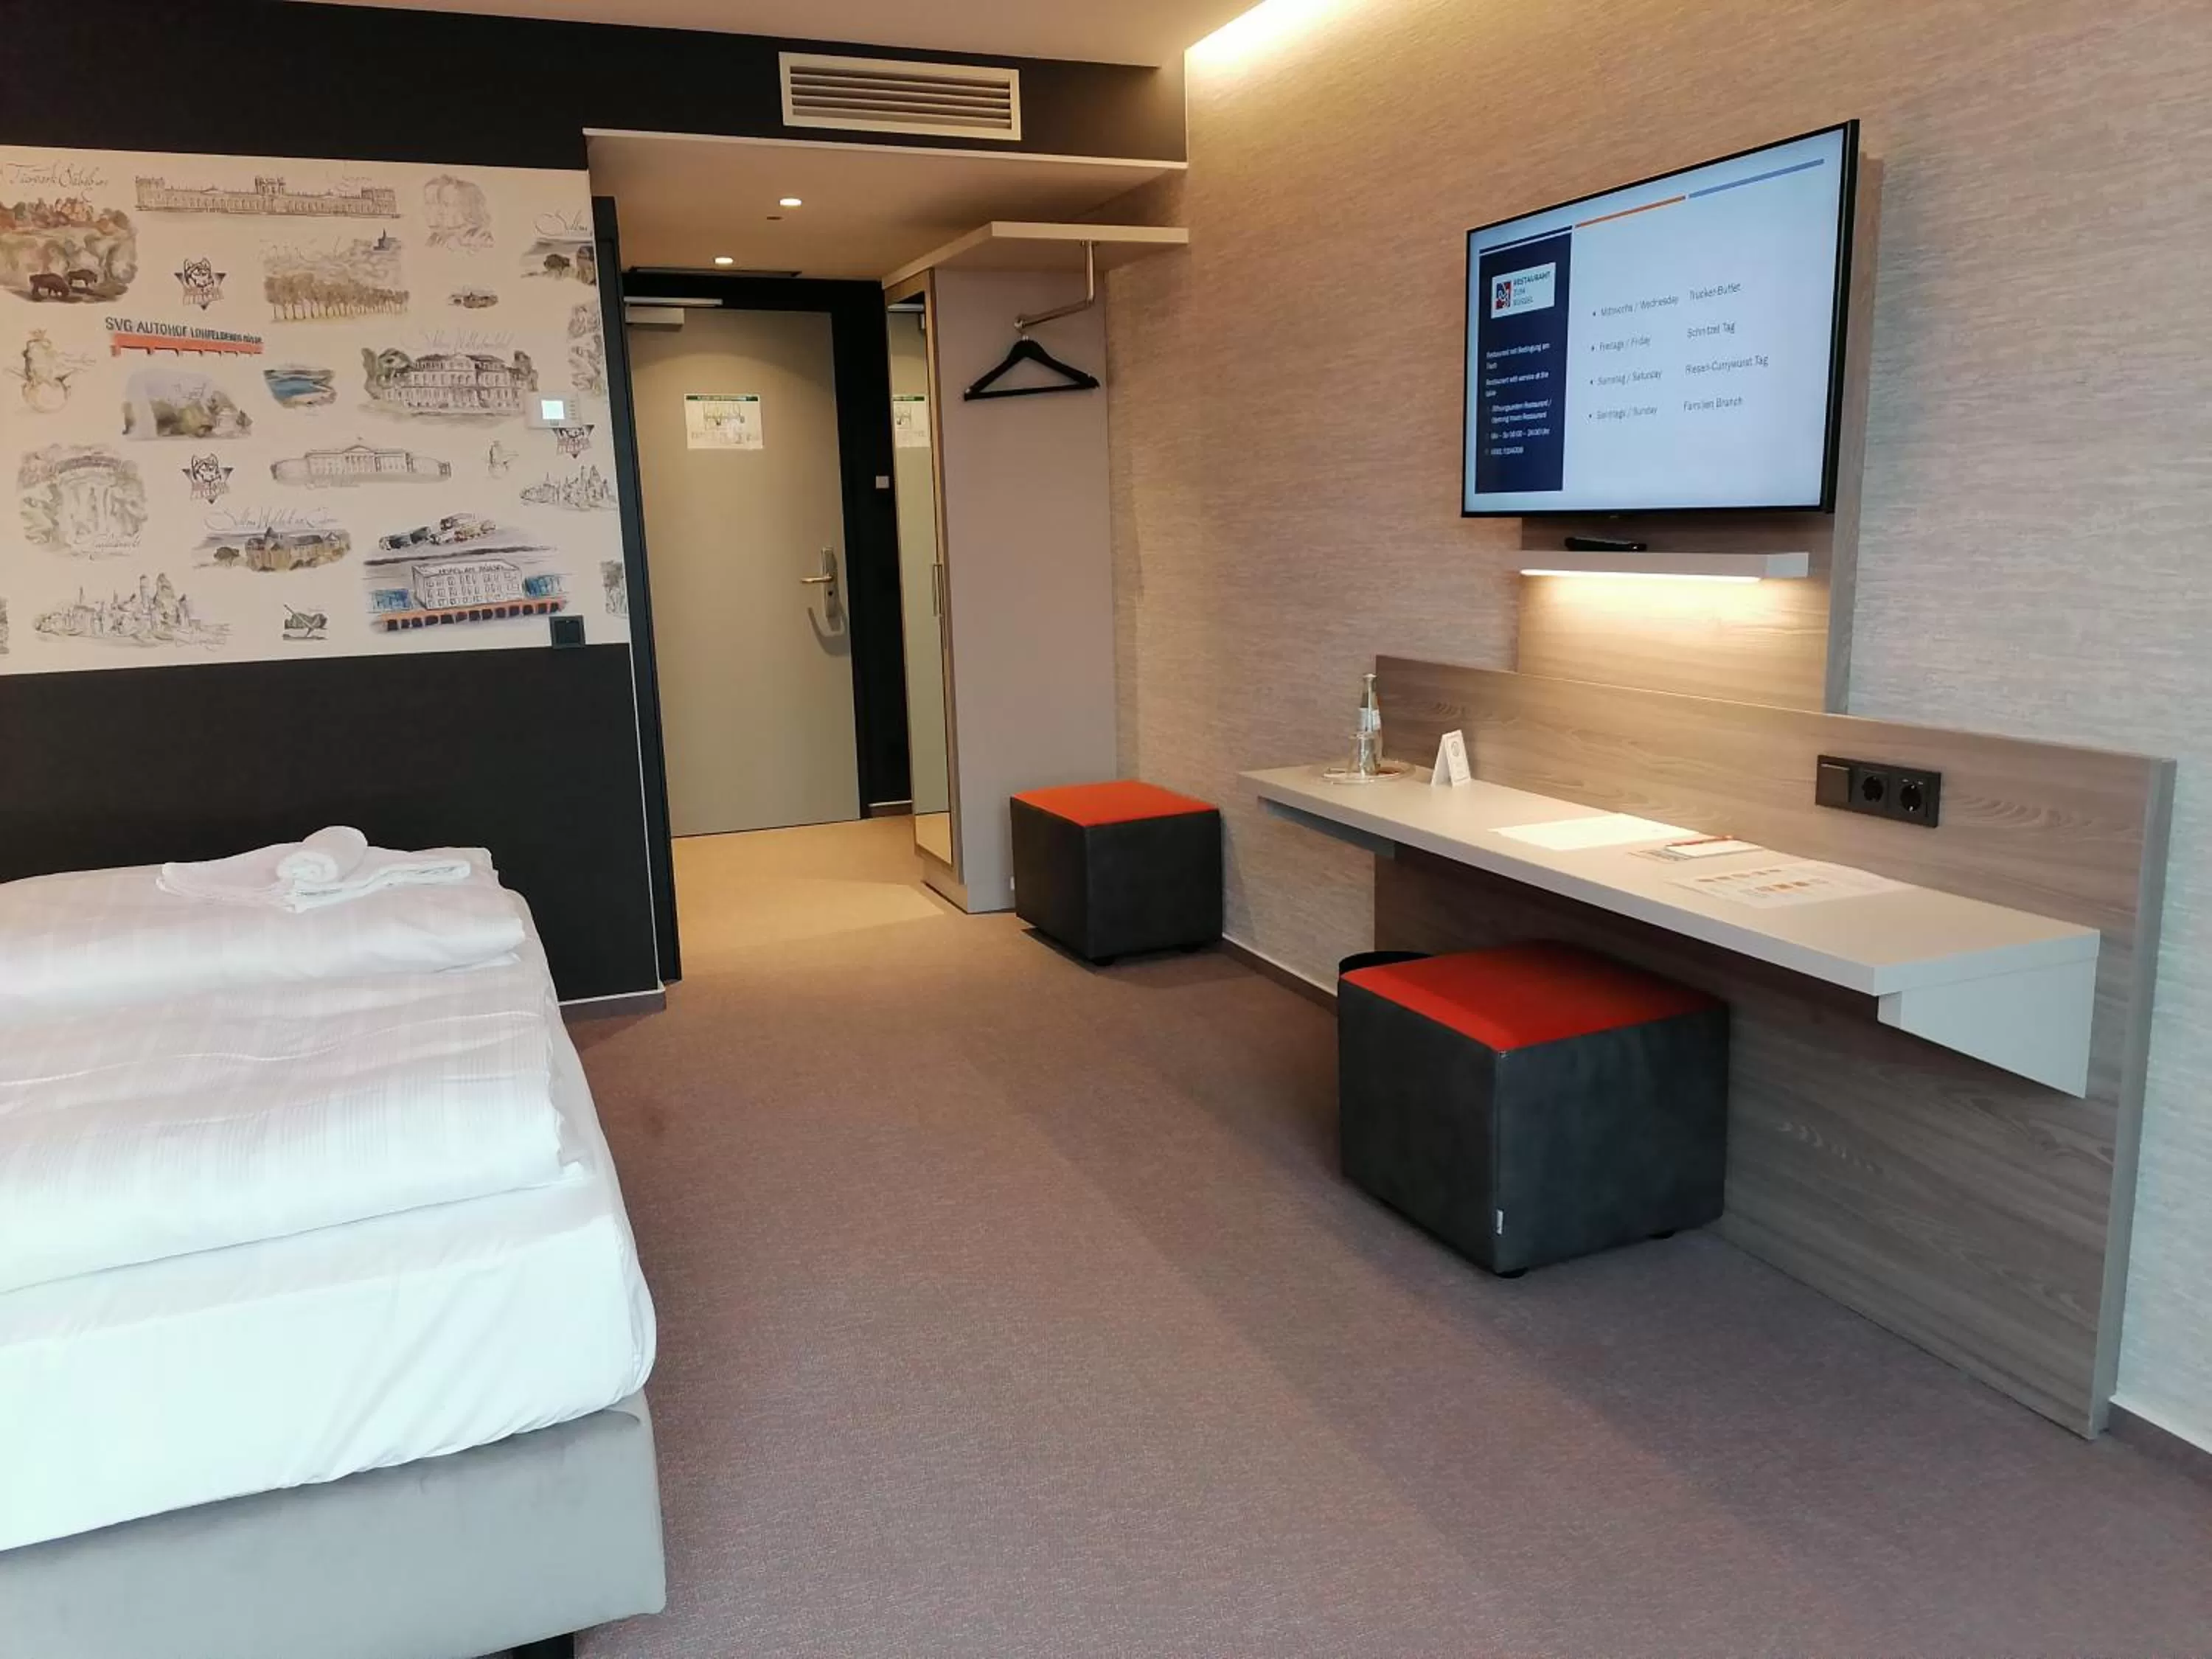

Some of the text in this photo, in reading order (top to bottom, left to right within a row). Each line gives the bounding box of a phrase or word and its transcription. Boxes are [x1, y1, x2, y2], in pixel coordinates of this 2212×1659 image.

[1639, 295, 1679, 309] Wednesday
[105, 316, 133, 332] SVG
[136, 321, 187, 338] AUTOHOF
[1722, 322, 1735, 335] Tag
[1755, 354, 1769, 367] Tag
